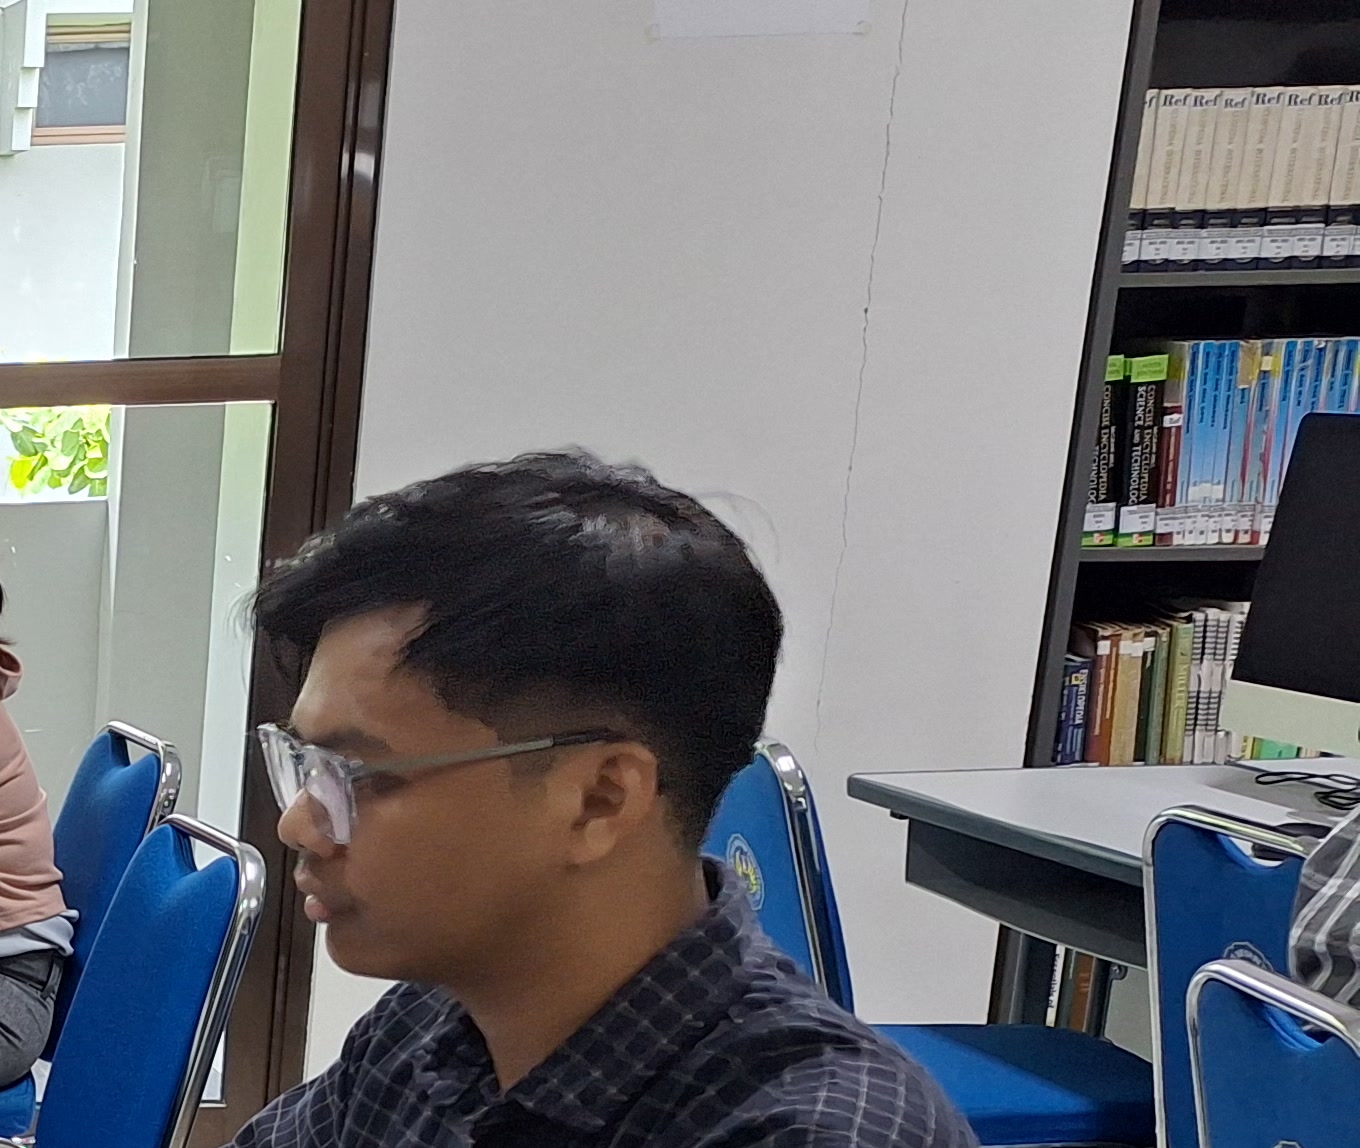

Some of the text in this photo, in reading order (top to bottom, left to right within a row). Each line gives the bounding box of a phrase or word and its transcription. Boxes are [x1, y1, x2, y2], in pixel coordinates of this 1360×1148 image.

[1134, 386, 1146, 426] SCIENCE
[1098, 429, 1110, 501] ENCYCLOPEDIA
[1129, 445, 1142, 505] TECHNOLOG
[1139, 384, 1156, 501] CONCISE ENCYCLOPEDIA
